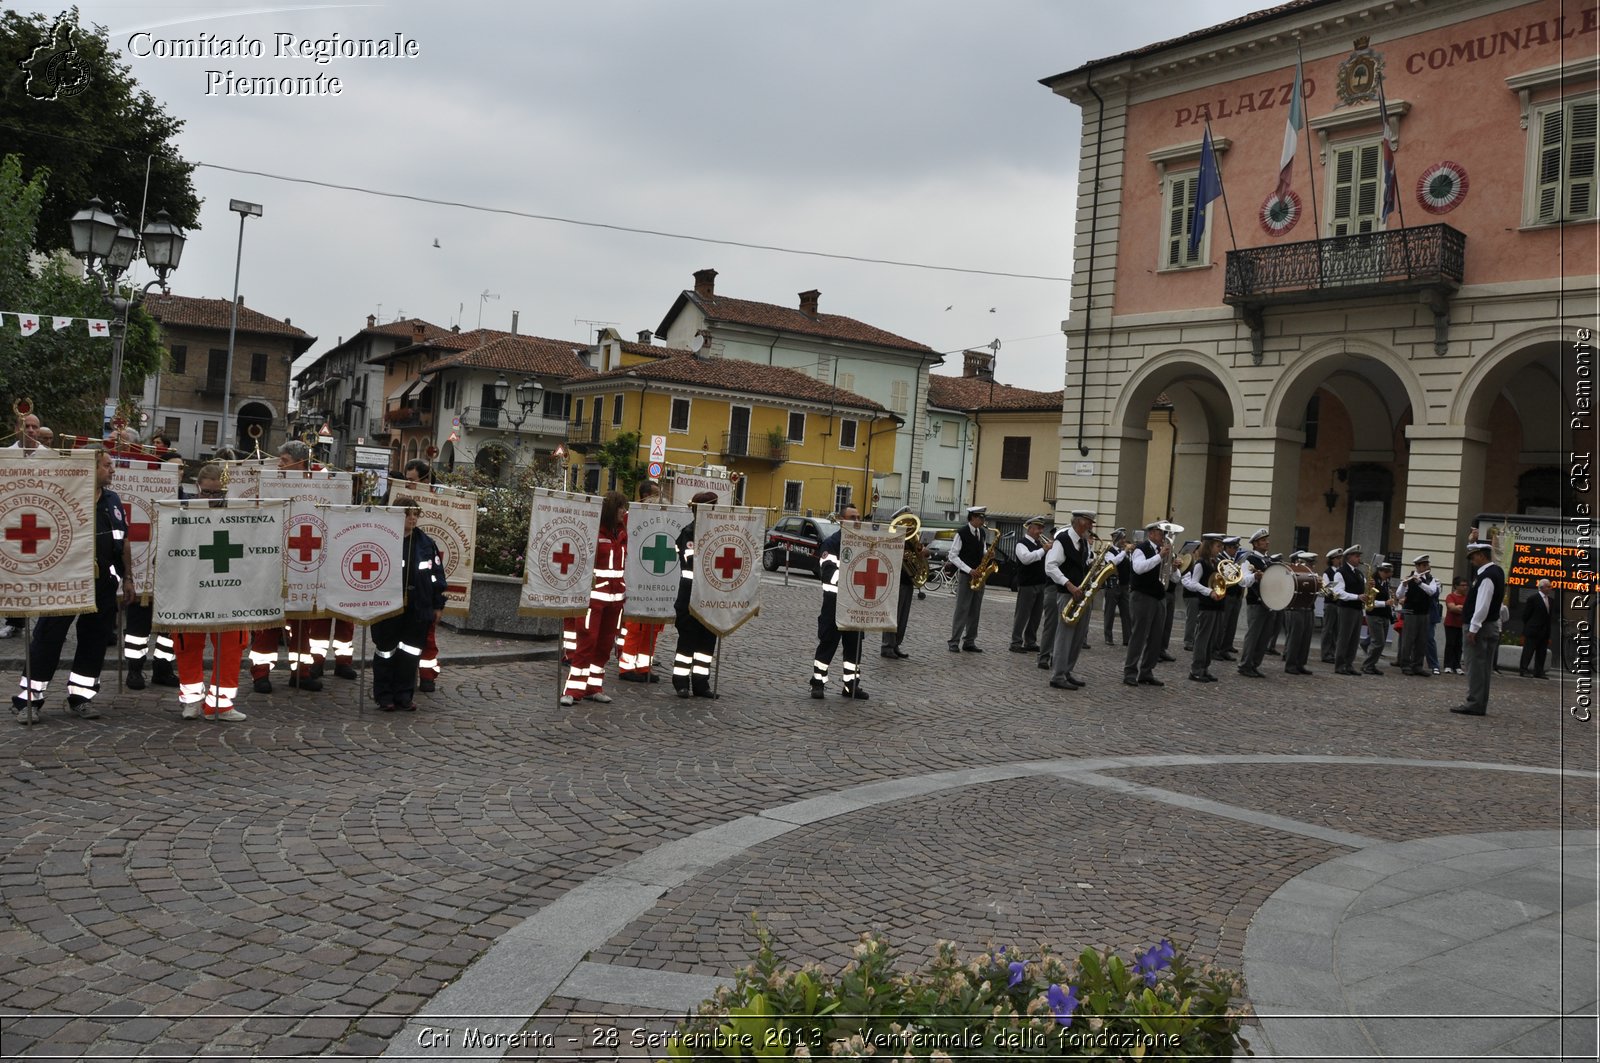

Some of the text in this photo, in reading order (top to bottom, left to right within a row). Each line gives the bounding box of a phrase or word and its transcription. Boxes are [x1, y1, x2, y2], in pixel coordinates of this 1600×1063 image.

[1174, 8, 1600, 129] PALAZZO COMUNALE
[0, 468, 89, 477] OLONTARI DEL SOCCORSO
[143, 476, 172, 484] SOCCORSO
[108, 484, 176, 493] OSSA ITALIANA
[13, 495, 56, 512] GINEVRA
[48, 482, 89, 526] ITALIANA
[55, 509, 66, 521] 22
[219, 515, 275, 524] ASSISTENZA
[334, 523, 361, 540] VOLONTARI
[374, 523, 400, 541] SOCCORSO
[420, 510, 471, 553] OSSA ITALIANA
[632, 517, 682, 537] CROCE VER
[714, 524, 740, 534] ROSSA
[531, 522, 552, 551] CROCE
[552, 515, 576, 527] ROSSA
[58, 524, 70, 555] AGOSTO
[248, 546, 280, 555] VERDE
[1515, 544, 1531, 553] TRE
[1518, 556, 1562, 567] APERTURA
[0, 580, 89, 593] PPO DI MELLE
[199, 579, 242, 588] SALUZZO
[638, 584, 676, 592] PINEROLO
[0, 594, 87, 607] TATO LOCALE
[700, 600, 750, 609] SAVIGLIANO
[157, 612, 215, 620] VOLONTARI
[232, 608, 281, 617] SOCCORSO
[850, 615, 885, 624] MORETTA
